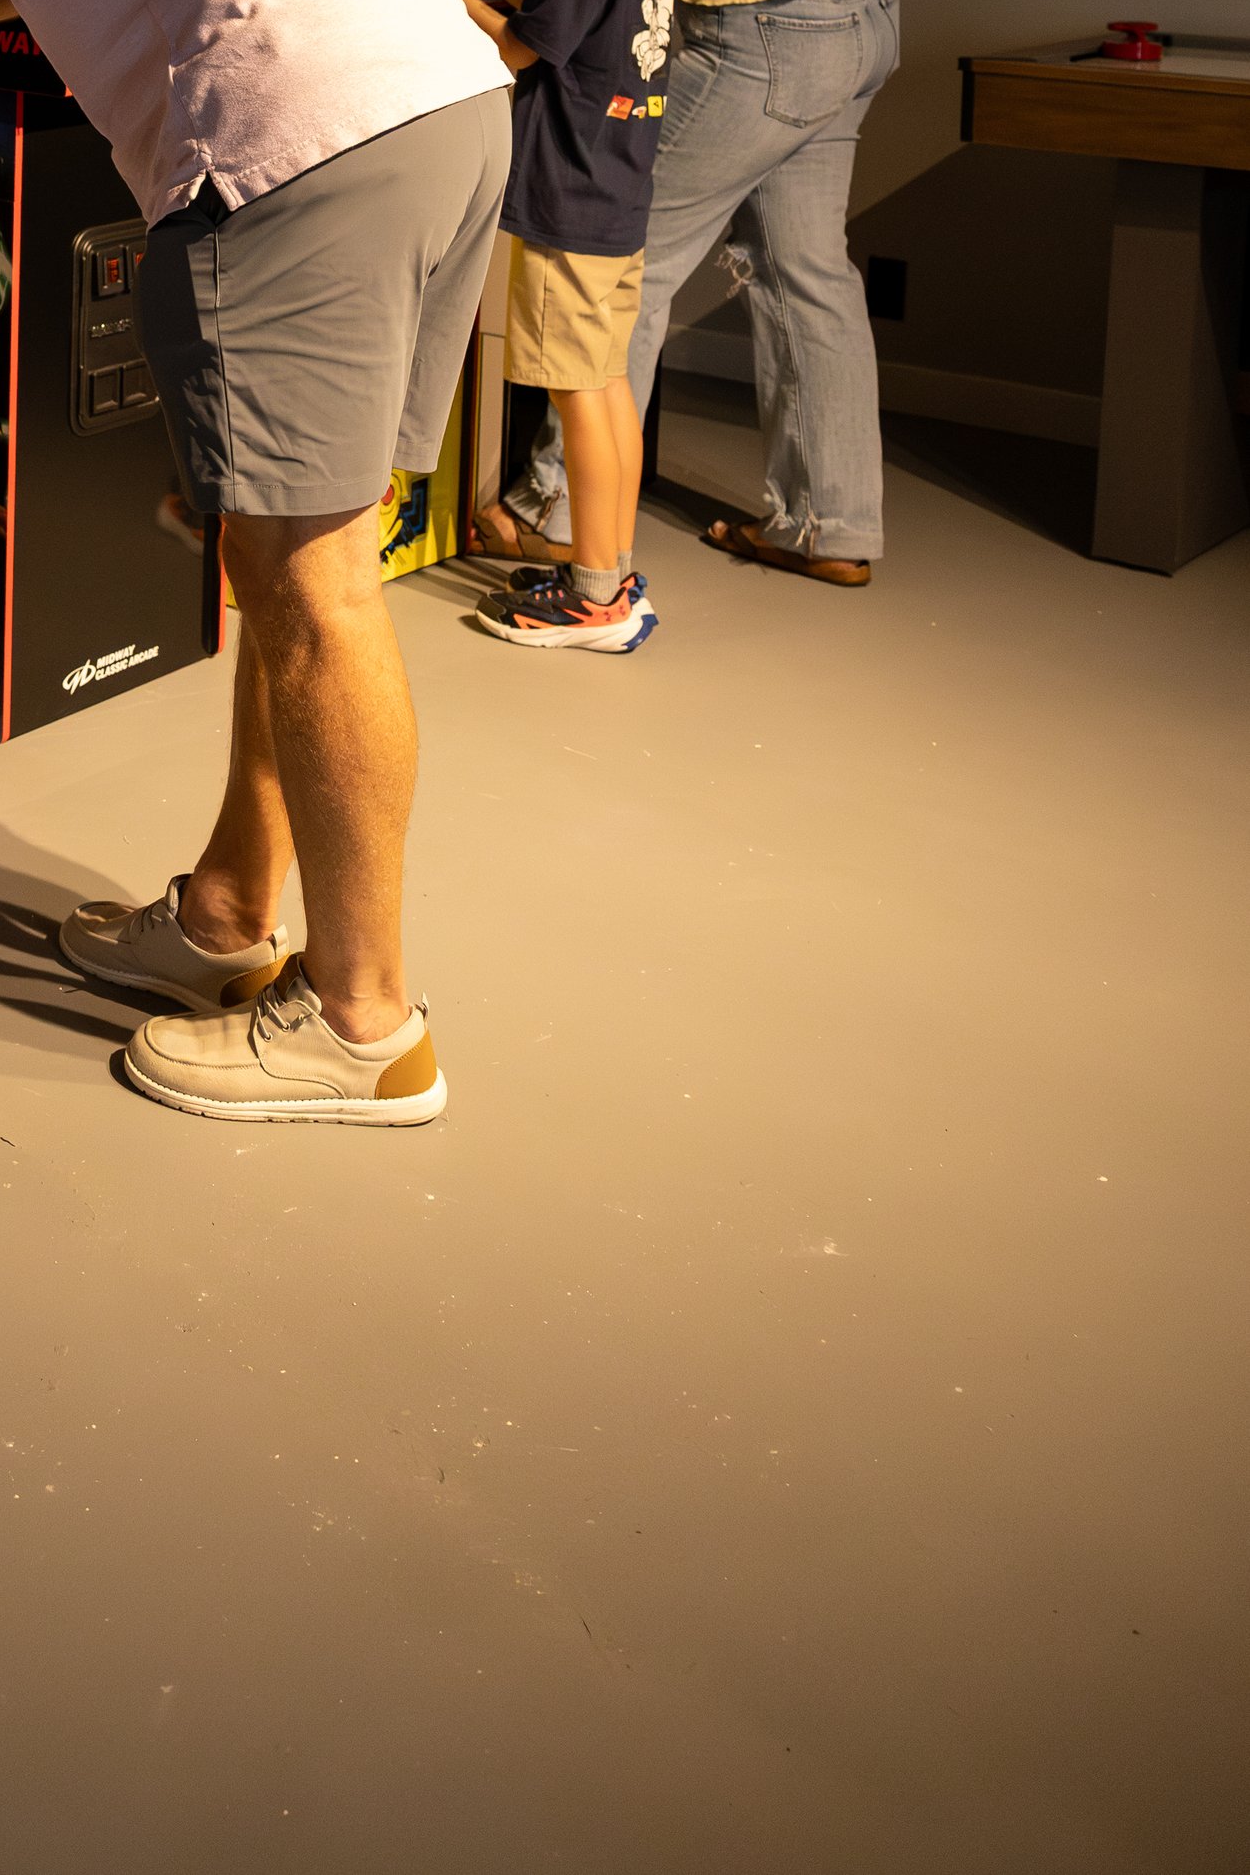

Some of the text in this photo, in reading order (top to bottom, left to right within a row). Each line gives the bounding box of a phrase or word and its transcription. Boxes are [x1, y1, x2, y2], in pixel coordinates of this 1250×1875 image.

[95, 645, 160, 681] CLASSIC ARCADE
[96, 643, 136, 669] MIDWAY
